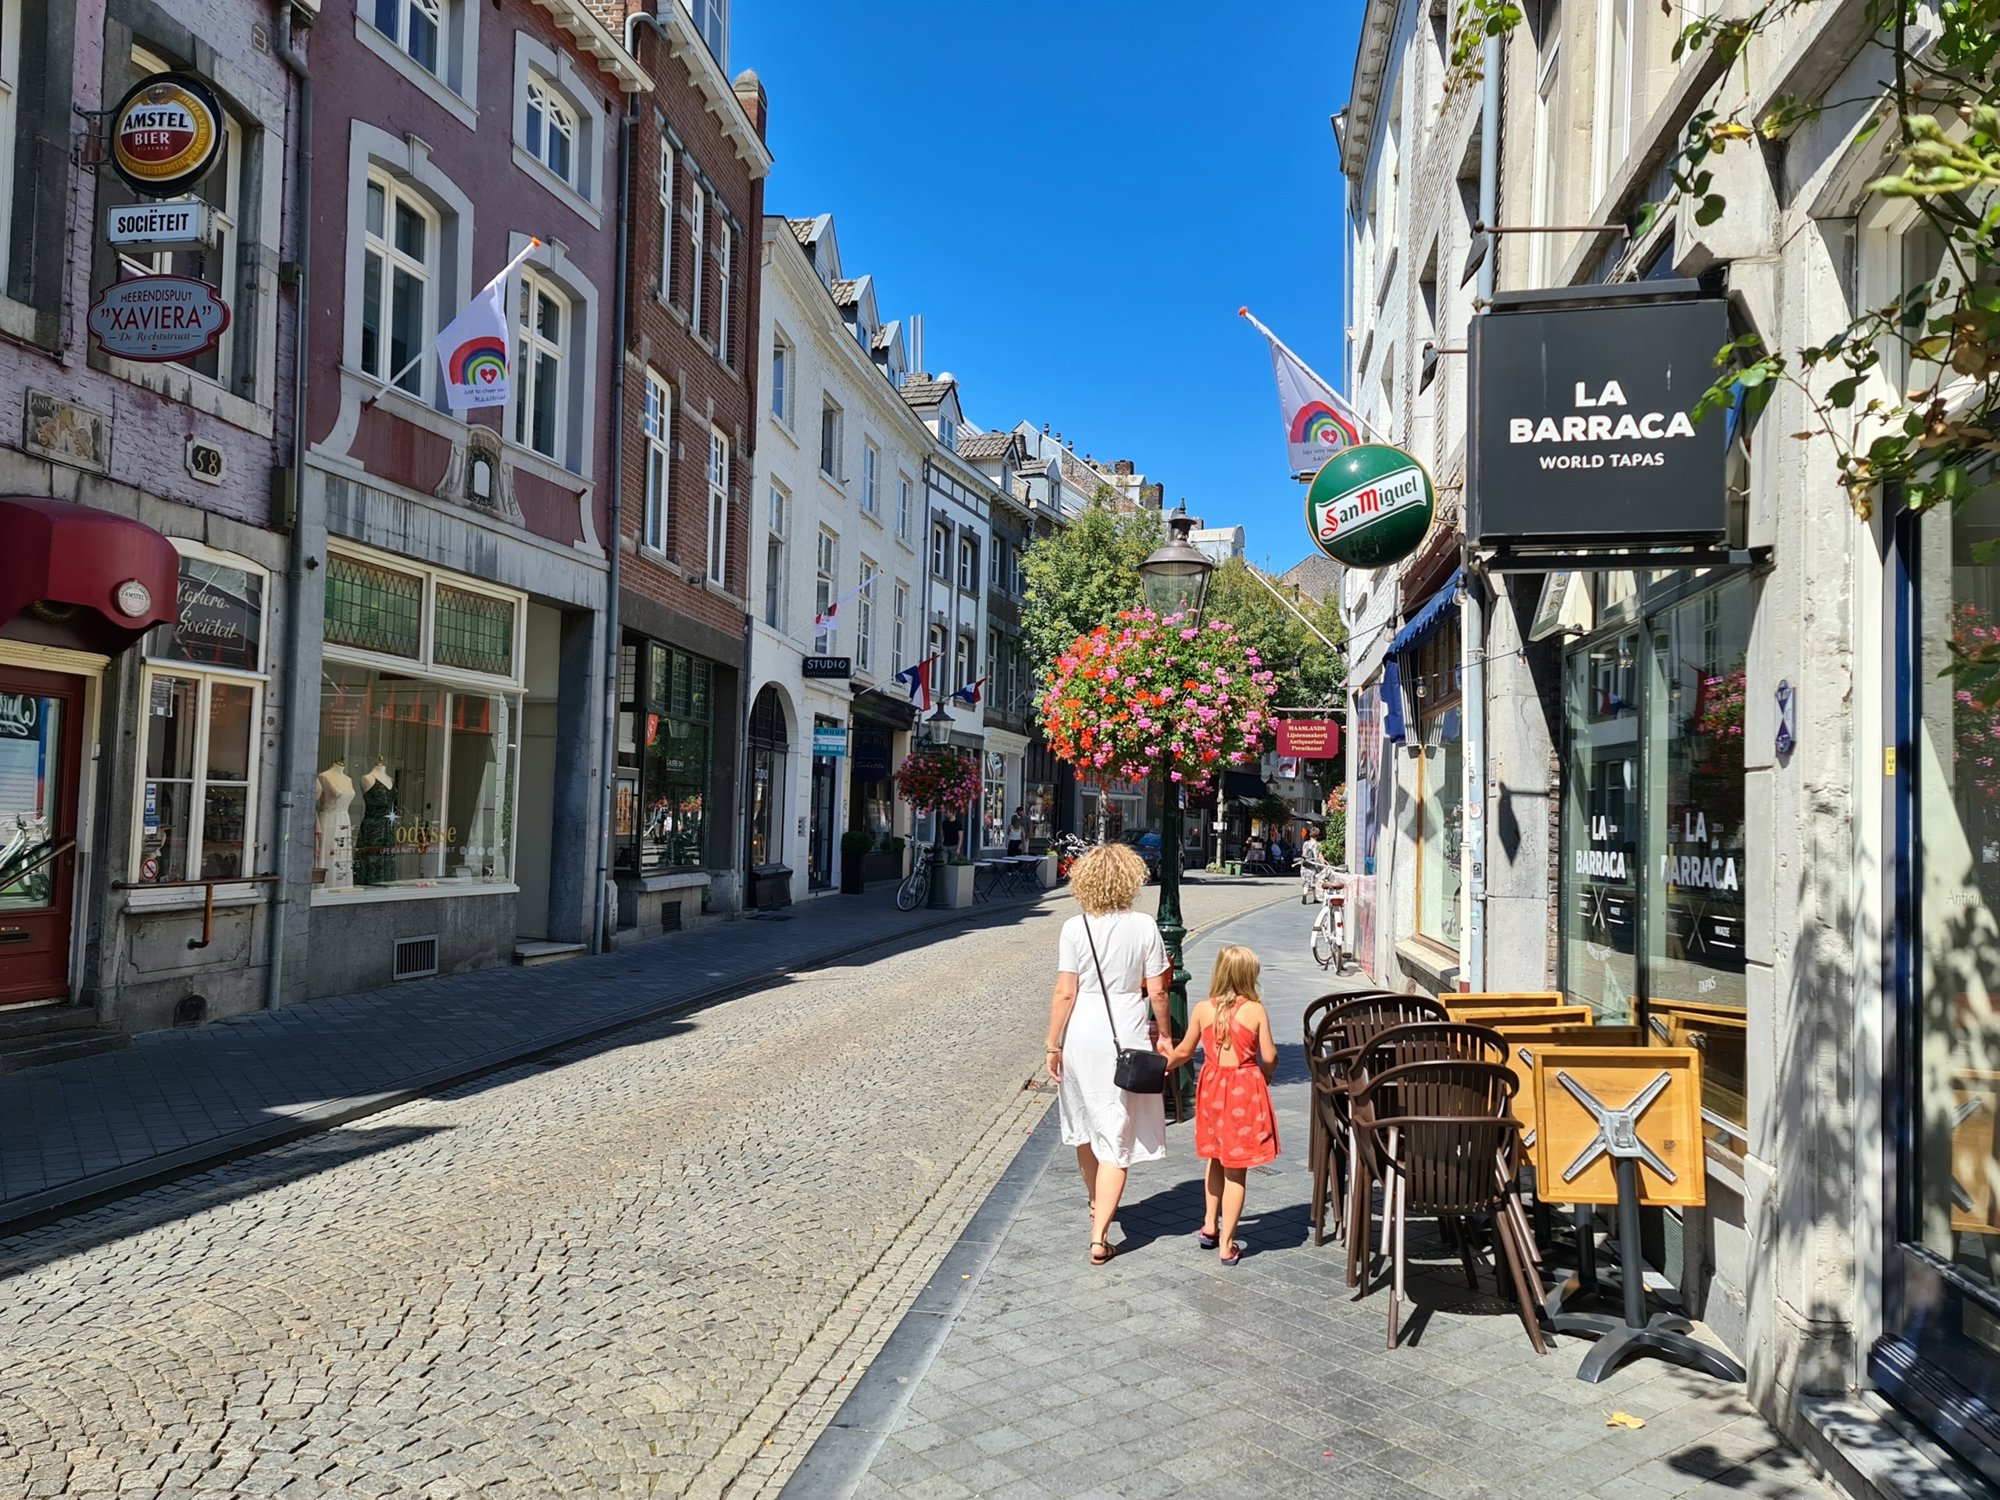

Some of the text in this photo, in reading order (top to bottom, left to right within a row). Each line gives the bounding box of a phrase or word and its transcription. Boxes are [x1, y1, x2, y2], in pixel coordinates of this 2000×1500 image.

[124, 112, 188, 132] AMSTEL
[135, 132, 170, 145] BIER
[117, 209, 189, 233] SOCIËTEIT
[121, 289, 192, 303] HEERENDISPUUT
[1575, 380, 1628, 408] LA
[1510, 411, 1696, 443] BARRACA
[197, 450, 218, 475] 58
[1539, 452, 1665, 470] WORLD TAPAS
[124, 591, 145, 601] AMSTEL
[807, 659, 847, 669] STUDIO
[1592, 815, 1608, 841] LA
[1685, 812, 1708, 843] LA
[1576, 850, 1626, 879] BARRACA
[1661, 855, 1738, 891] BARRACA
